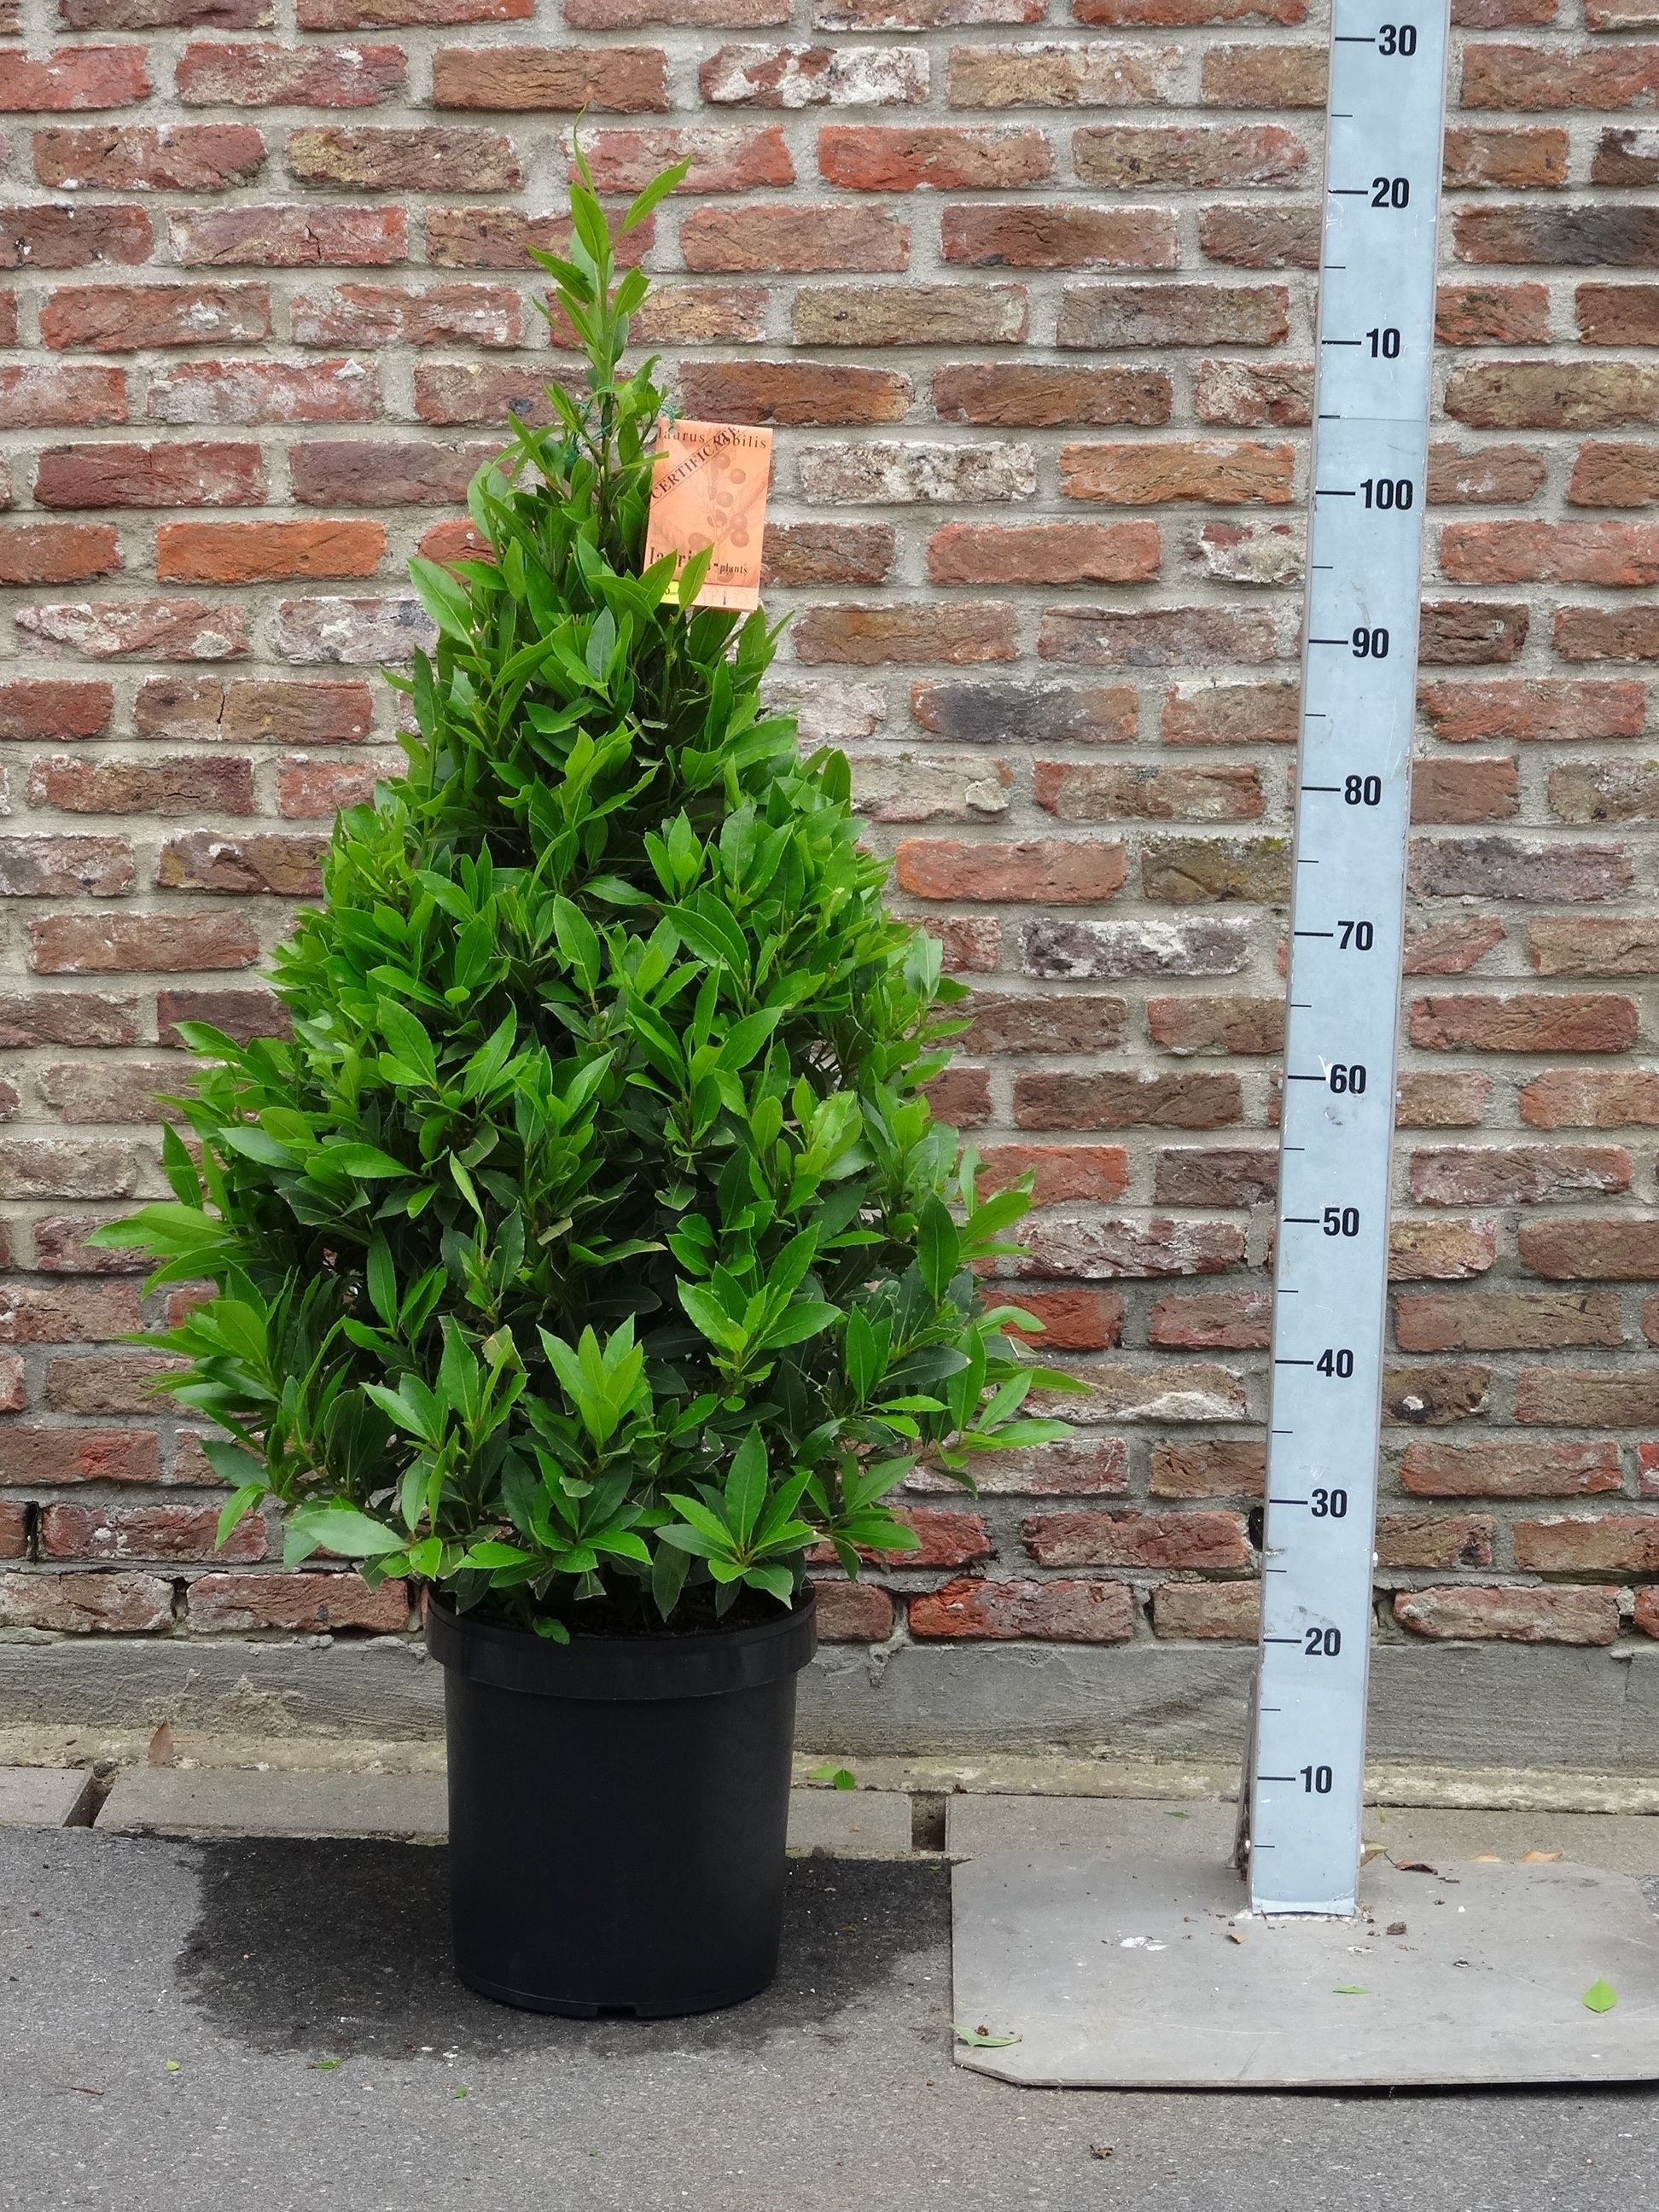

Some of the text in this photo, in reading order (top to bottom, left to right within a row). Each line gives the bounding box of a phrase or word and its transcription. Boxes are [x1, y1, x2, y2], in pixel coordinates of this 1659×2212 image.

[1378, 24, 1417, 56] 30
[1371, 177, 1410, 209] 20
[1365, 328, 1400, 359] 10
[657, 427, 767, 449] laurus nobilis
[650, 427, 740, 499] CERTIFICATE
[1359, 478, 1413, 510] 100
[1352, 627, 1389, 659] 90
[1344, 775, 1382, 806] 80
[1337, 920, 1374, 951] 70
[1330, 1063, 1366, 1095] 60
[1323, 1207, 1359, 1237] 50
[1316, 1348, 1353, 1378] 40
[1311, 1488, 1348, 1518] 30
[1305, 1627, 1342, 1656] 20
[1300, 1766, 1332, 1794] 10
